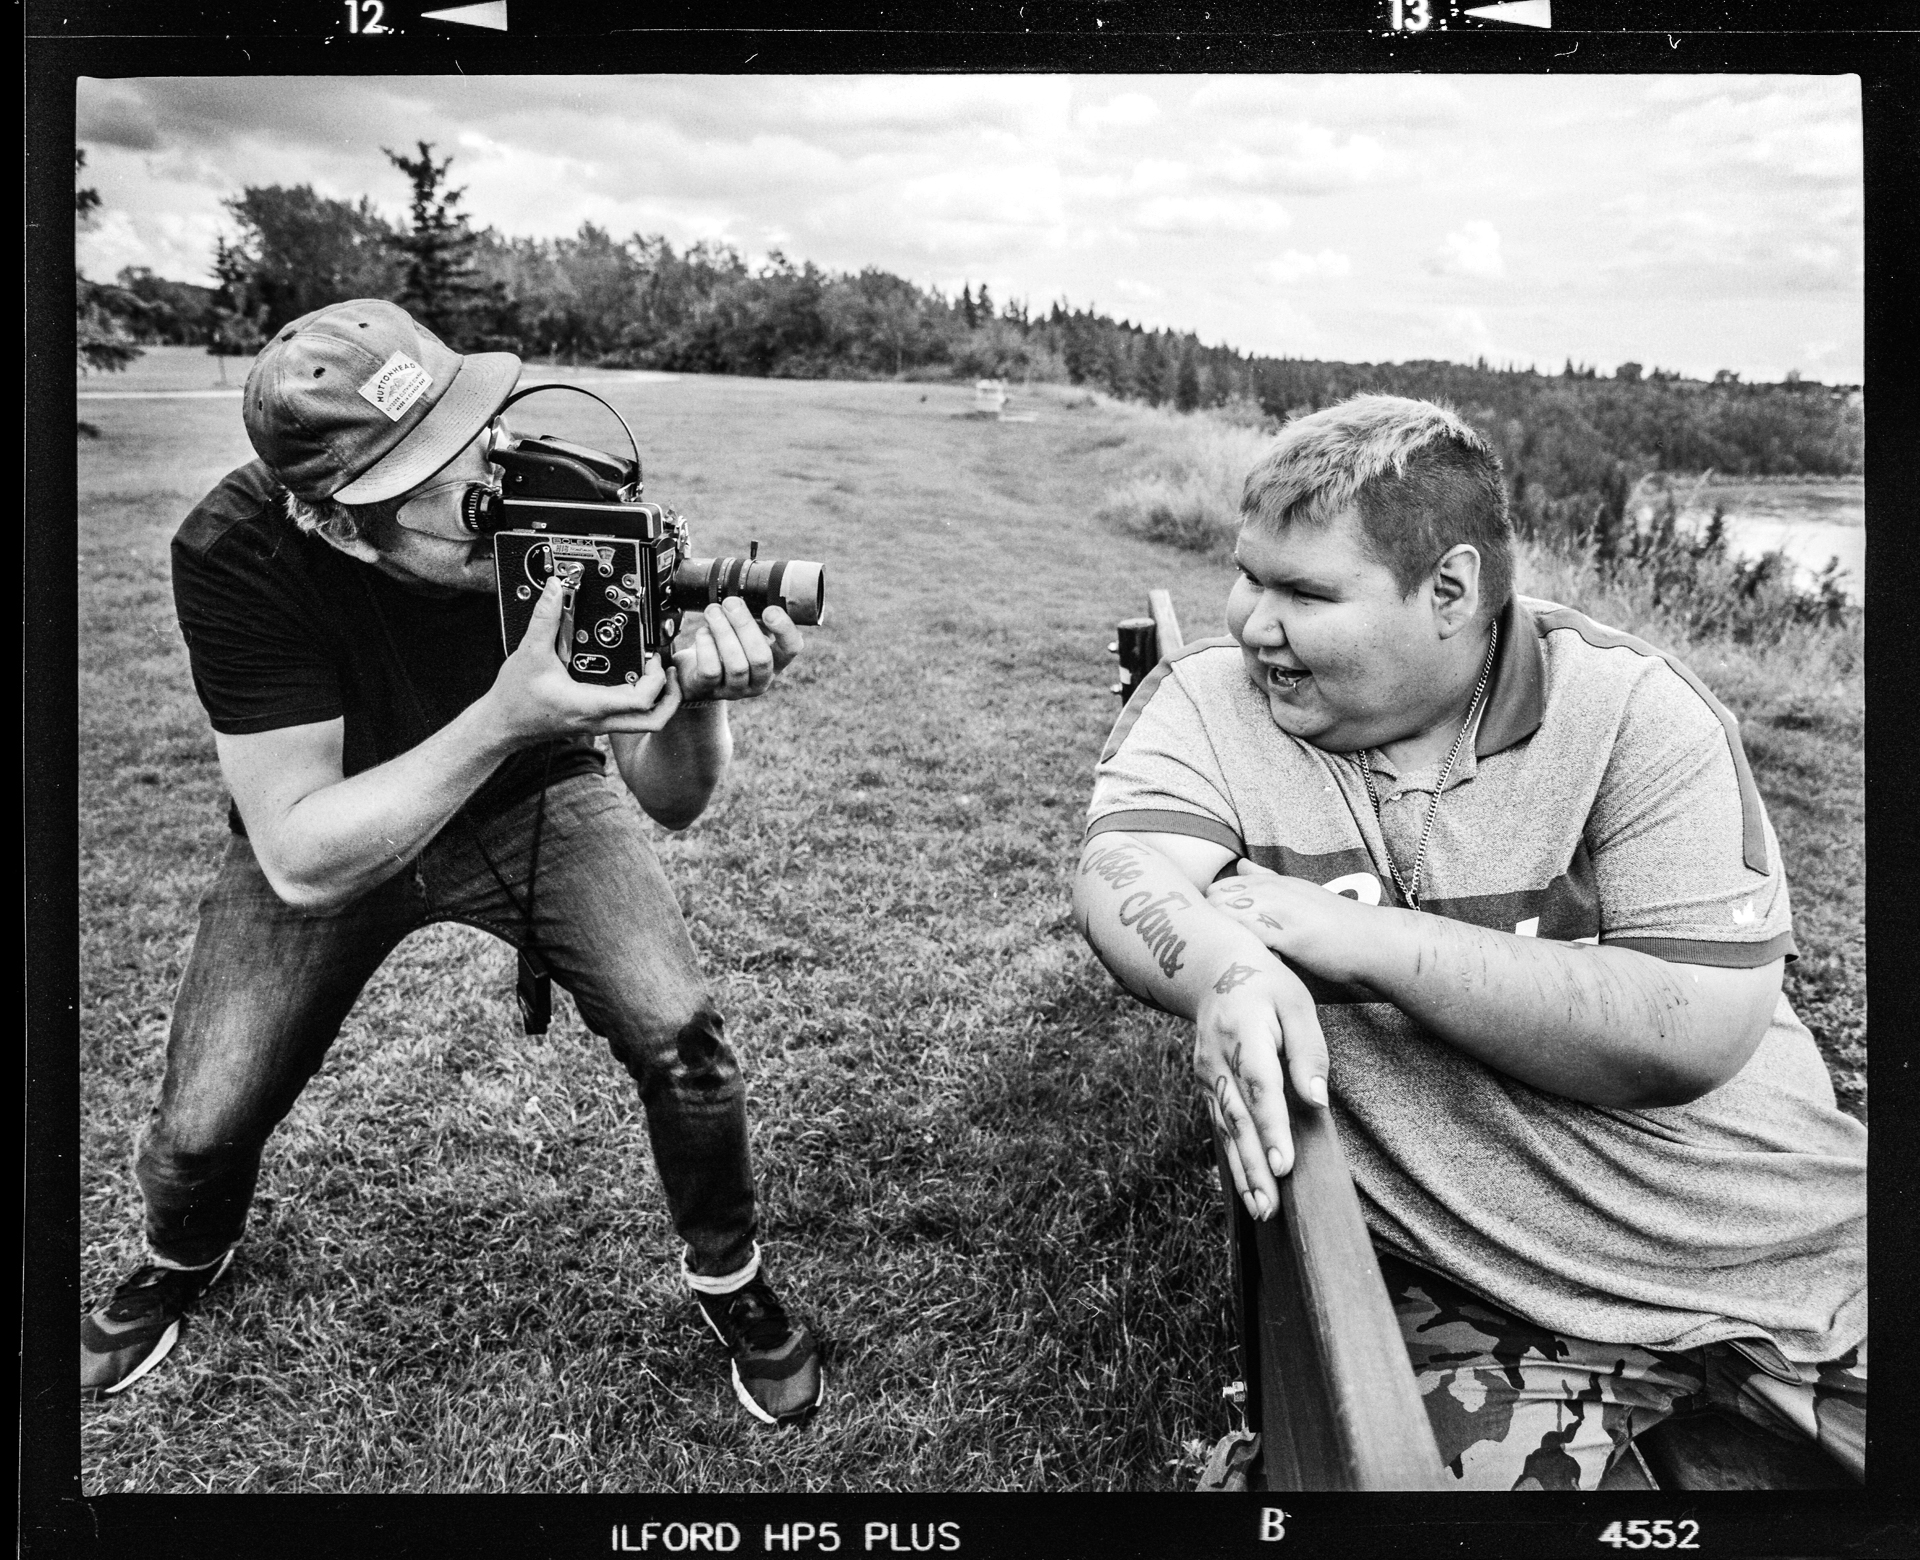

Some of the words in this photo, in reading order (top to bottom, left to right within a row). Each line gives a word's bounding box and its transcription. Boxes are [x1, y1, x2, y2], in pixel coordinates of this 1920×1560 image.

[345, 0, 384, 34] 12
[1388, 0, 1430, 31] 13
[376, 362, 416, 403] MUTTONHEAD
[611, 1522, 741, 1551] ILFORD
[764, 1522, 842, 1551] HP5
[864, 1522, 961, 1551] PLUS
[1260, 1507, 1286, 1541] B
[1598, 1519, 1701, 1549] 4552
